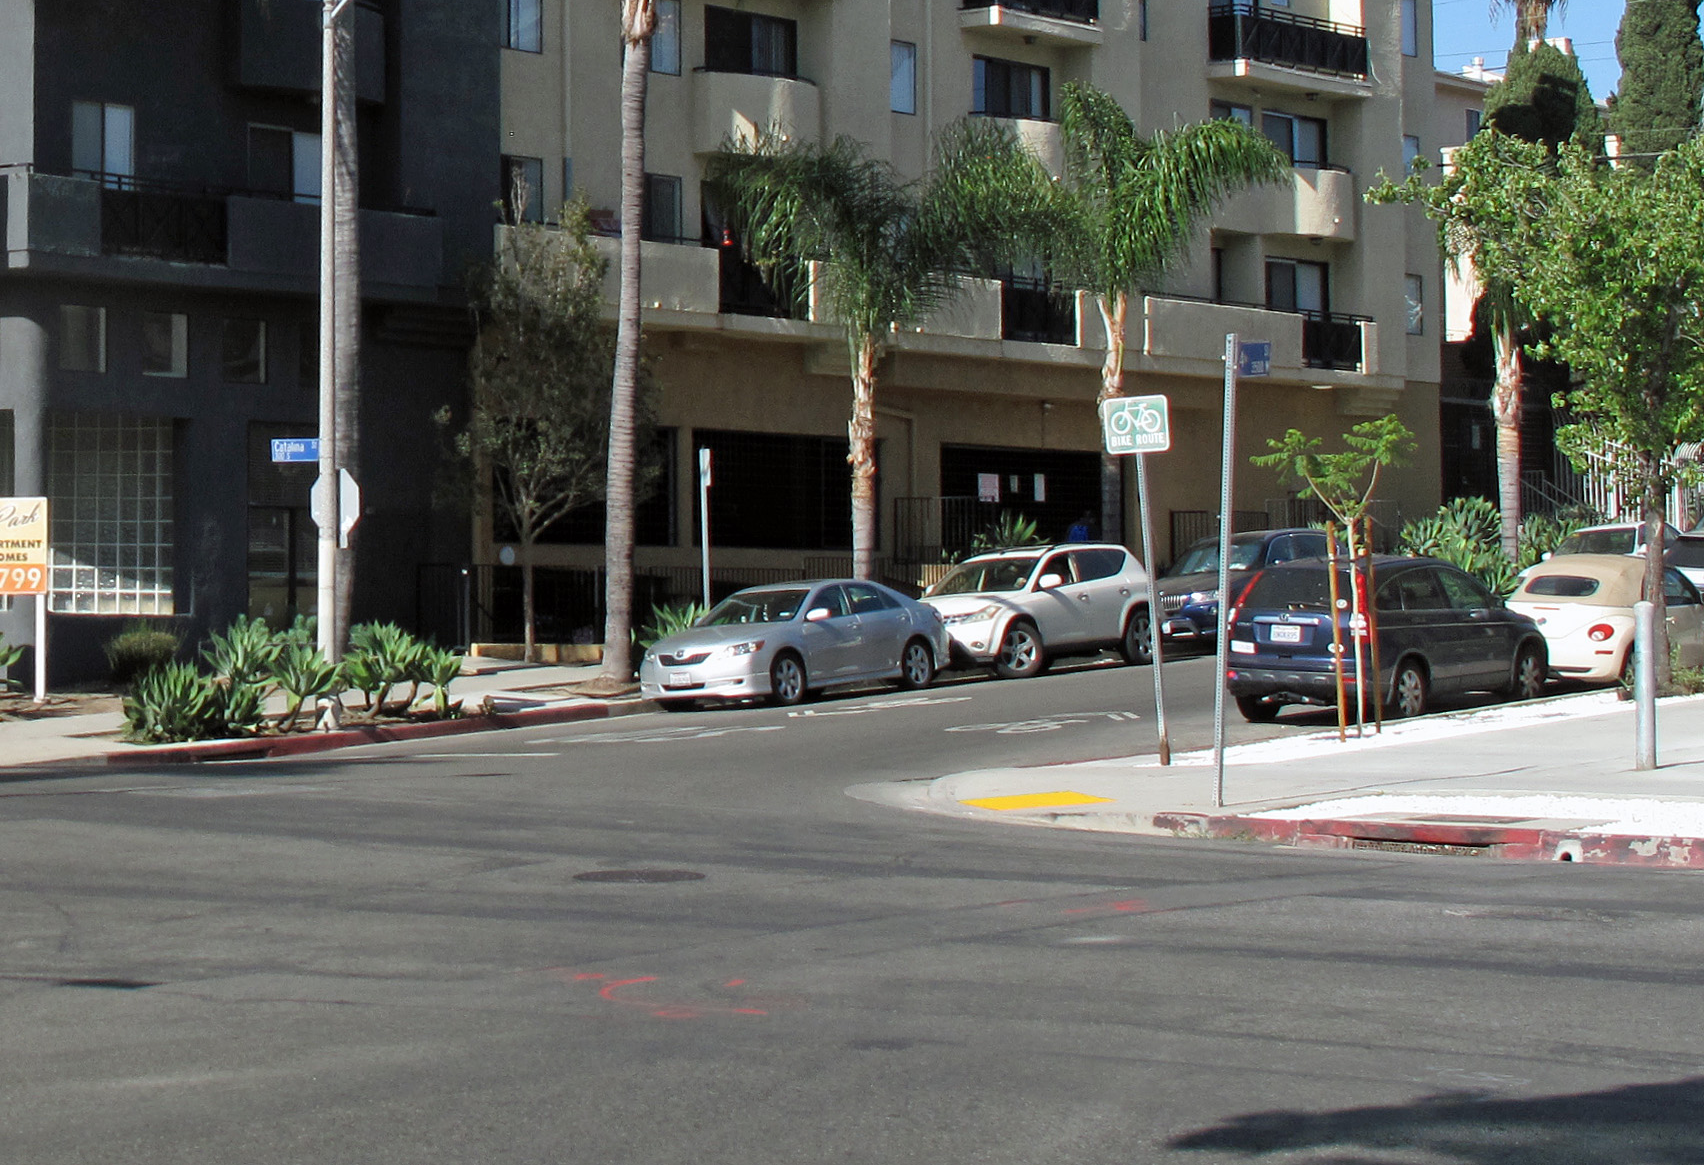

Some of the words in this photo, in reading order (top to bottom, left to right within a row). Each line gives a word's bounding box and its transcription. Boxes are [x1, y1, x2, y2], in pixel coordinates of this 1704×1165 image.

[1111, 435, 1133, 447] BIKE
[1135, 432, 1165, 445] ROUTE
[274, 441, 305, 453] Catalina
